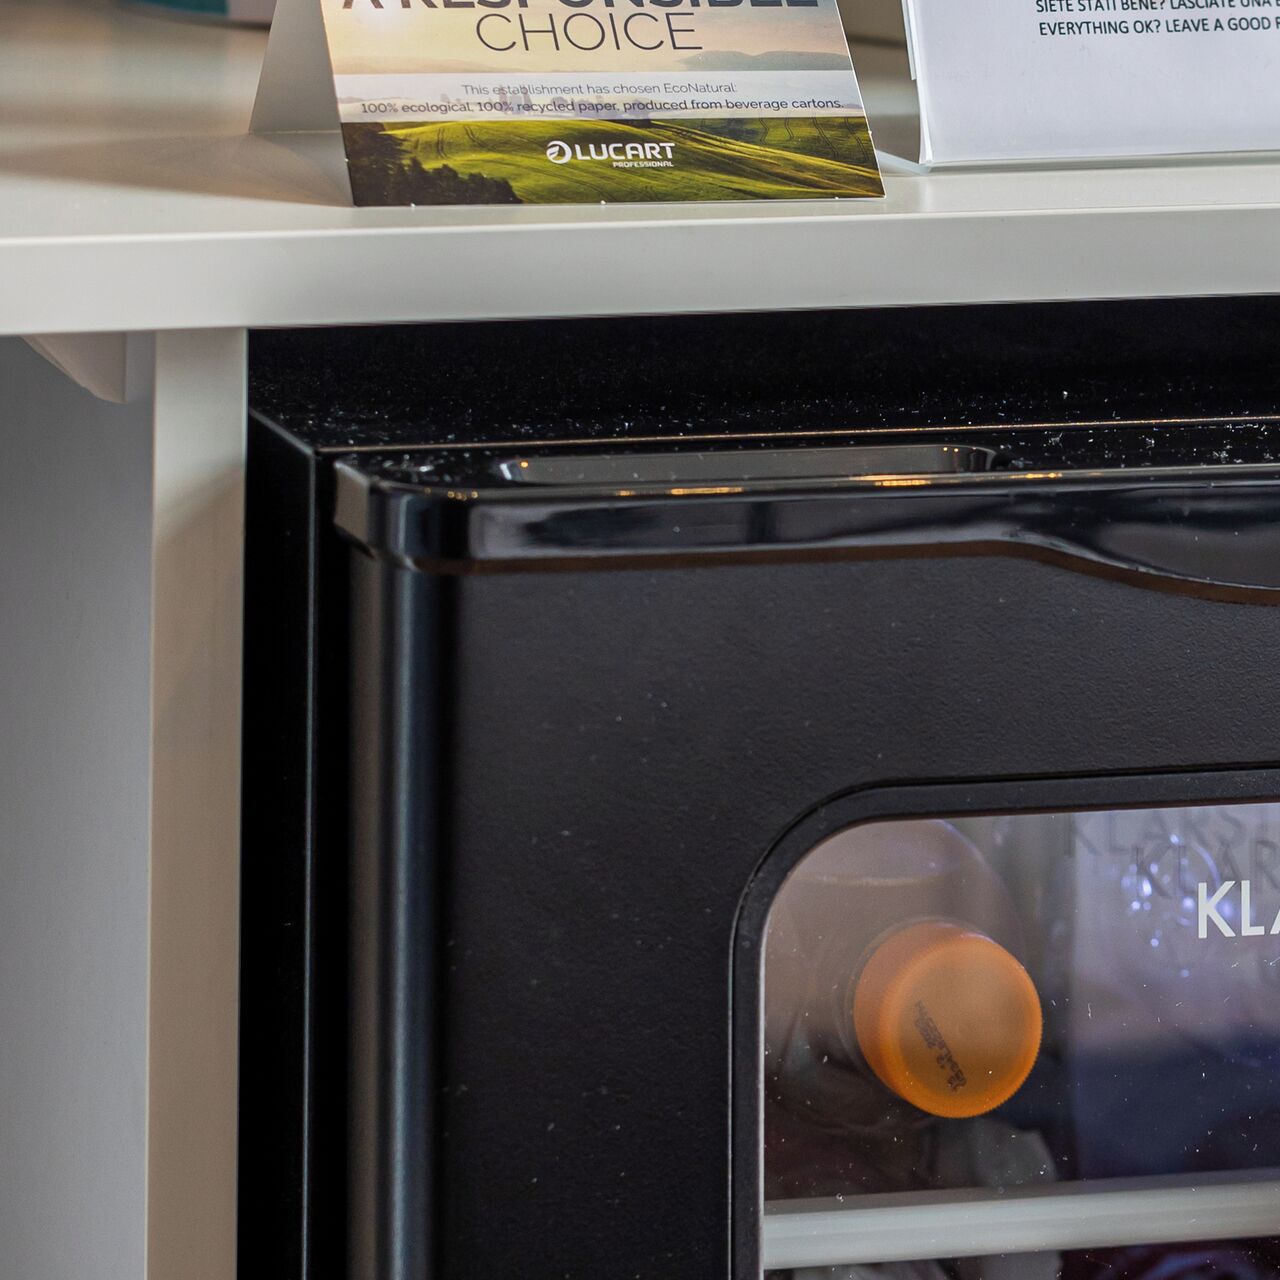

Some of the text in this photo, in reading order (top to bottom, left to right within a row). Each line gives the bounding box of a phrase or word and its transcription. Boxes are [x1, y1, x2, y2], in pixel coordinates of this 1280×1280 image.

[475, 11, 703, 52] CHOICE
[1039, 21, 1130, 36] EVERYTHING
[1133, 19, 1161, 34] OK?
[1165, 18, 1210, 33] LEAVE
[1213, 18, 1224, 31] A
[1227, 16, 1271, 31] GOOD
[461, 85, 490, 96] This
[493, 83, 584, 96] establishment
[587, 83, 610, 94] has
[613, 83, 661, 94] chosen
[362, 103, 399, 113] 100%
[477, 101, 514, 112] 100%
[517, 101, 575, 114] recycled
[578, 102, 620, 113] paper,
[623, 100, 687, 112] produced
[691, 99, 723, 109] from
[726, 98, 788, 111] beverage
[792, 98, 844, 109] cartons.
[574, 142, 676, 161] LUCART
